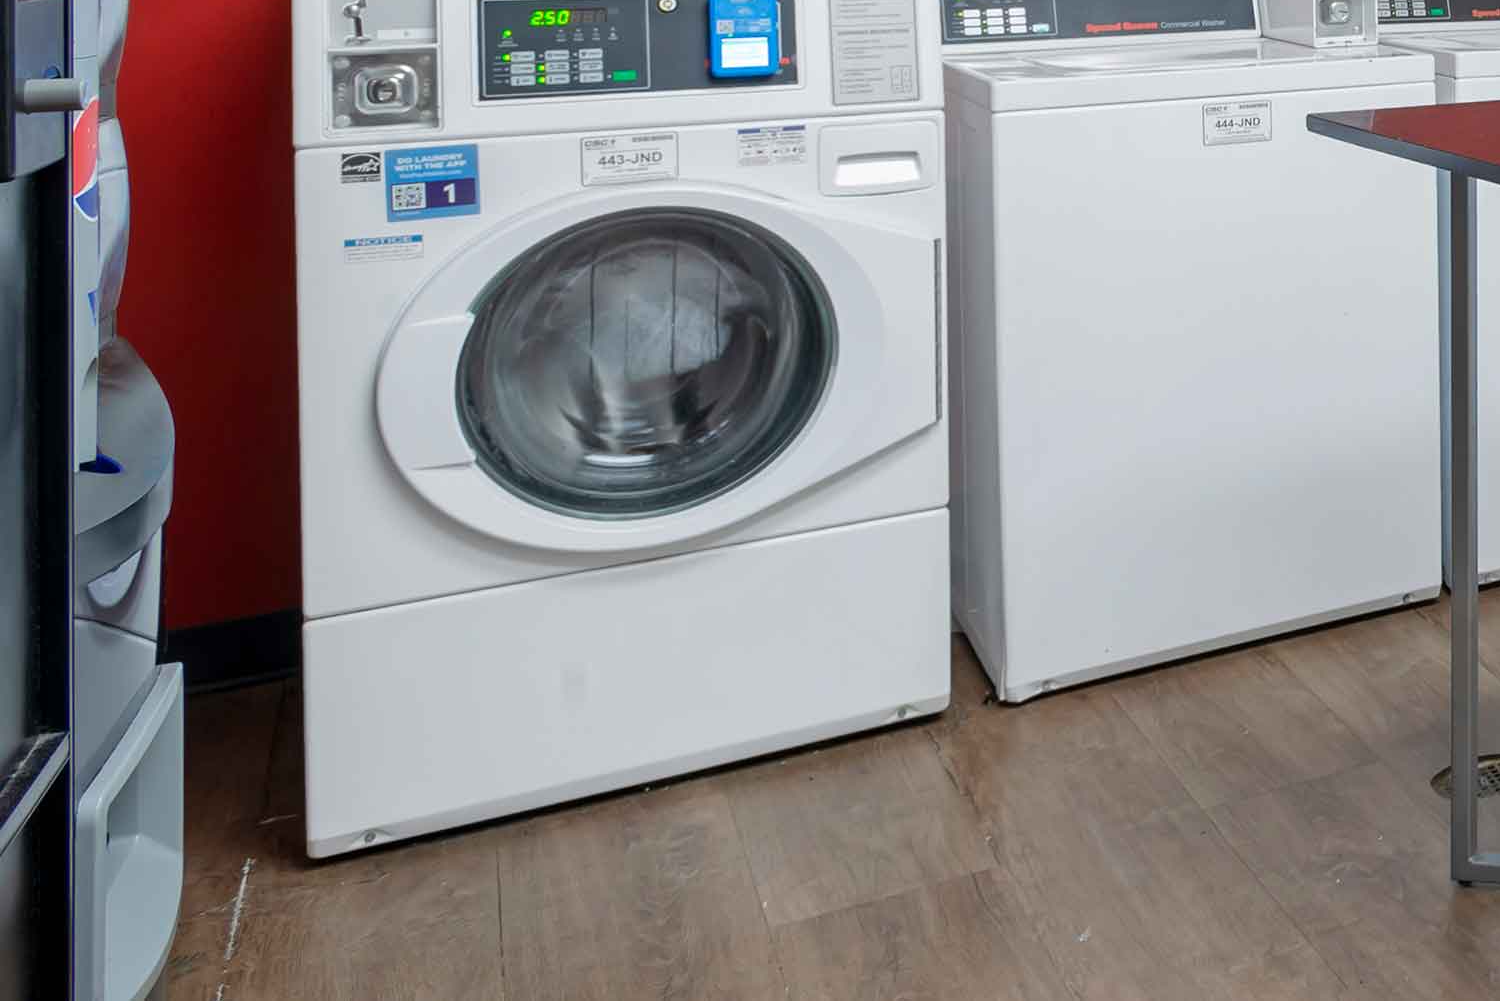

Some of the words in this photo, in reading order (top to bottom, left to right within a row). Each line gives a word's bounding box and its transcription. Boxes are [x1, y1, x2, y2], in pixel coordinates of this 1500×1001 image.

[1216, 117, 1261, 128] 444-JND
[597, 151, 663, 167] 443-JND
[443, 183, 456, 204] 1
